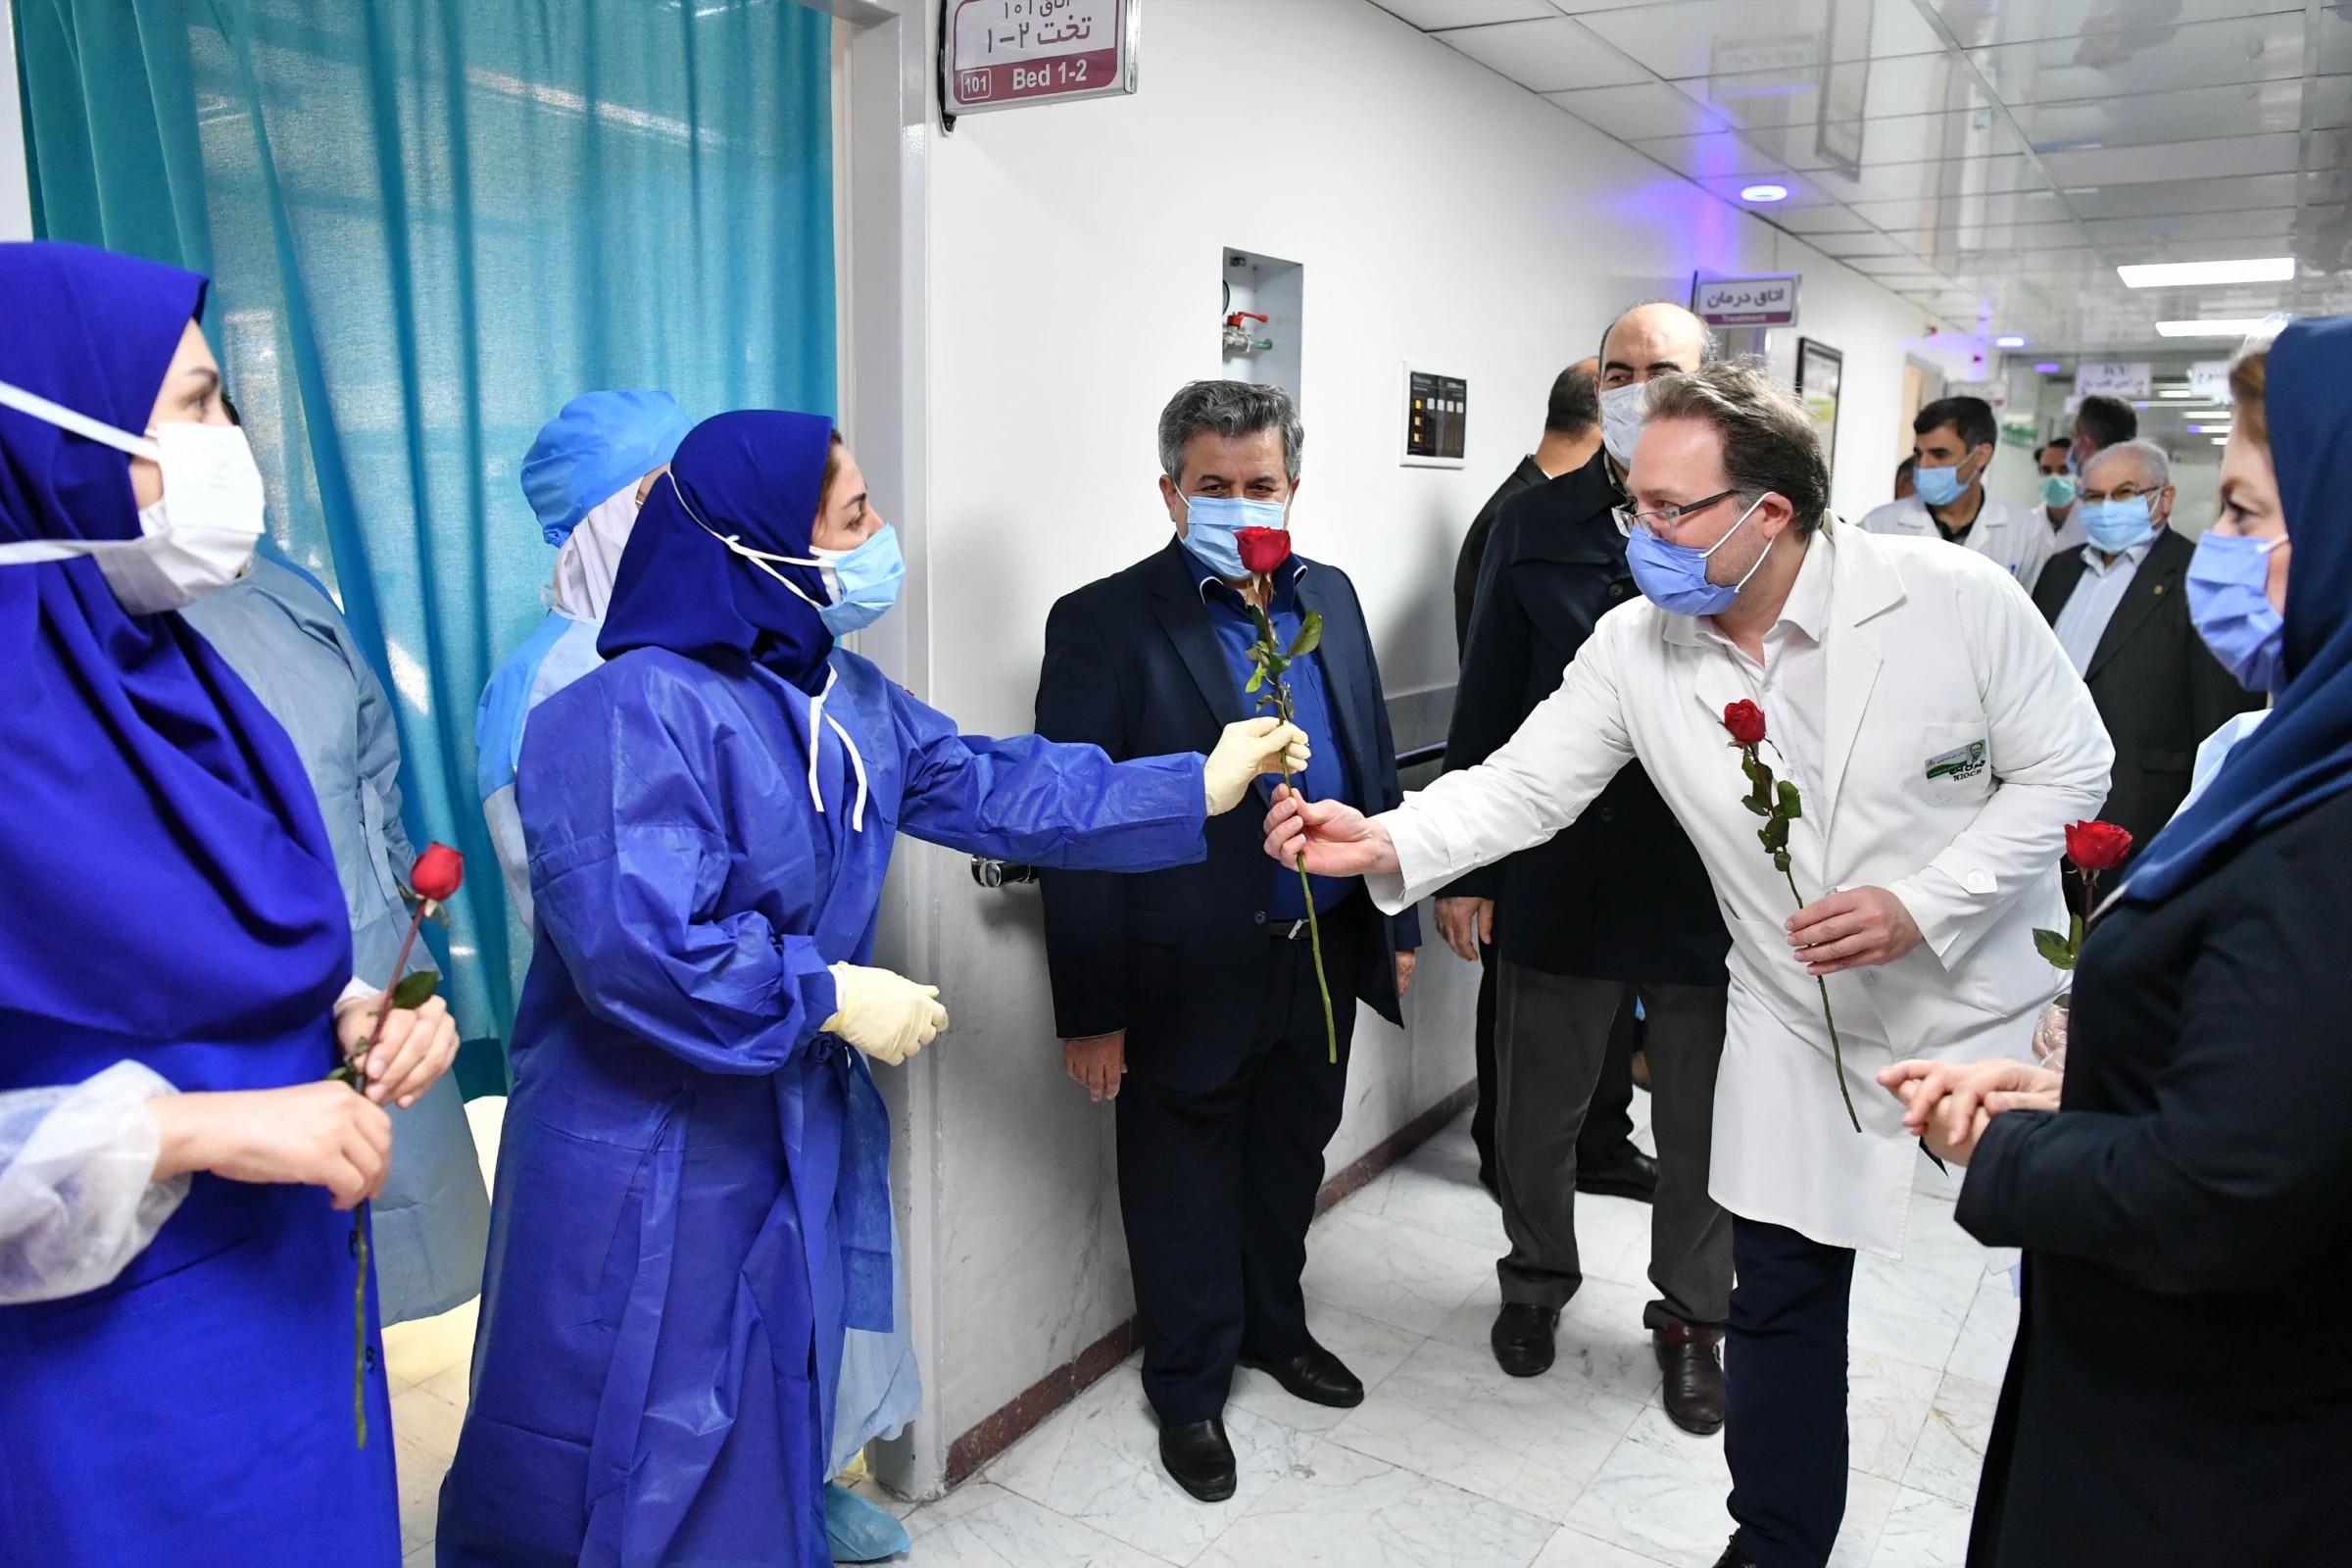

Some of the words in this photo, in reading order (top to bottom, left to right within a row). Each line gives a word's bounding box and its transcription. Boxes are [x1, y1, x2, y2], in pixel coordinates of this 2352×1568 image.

[1037, 15, 1092, 45] تخت
[1013, 64, 1051, 90] Bed
[1057, 60, 1088, 84] 1-2
[964, 76, 987, 94] 101
[1707, 291, 1751, 309] درمان
[1754, 288, 1785, 307] اتاق
